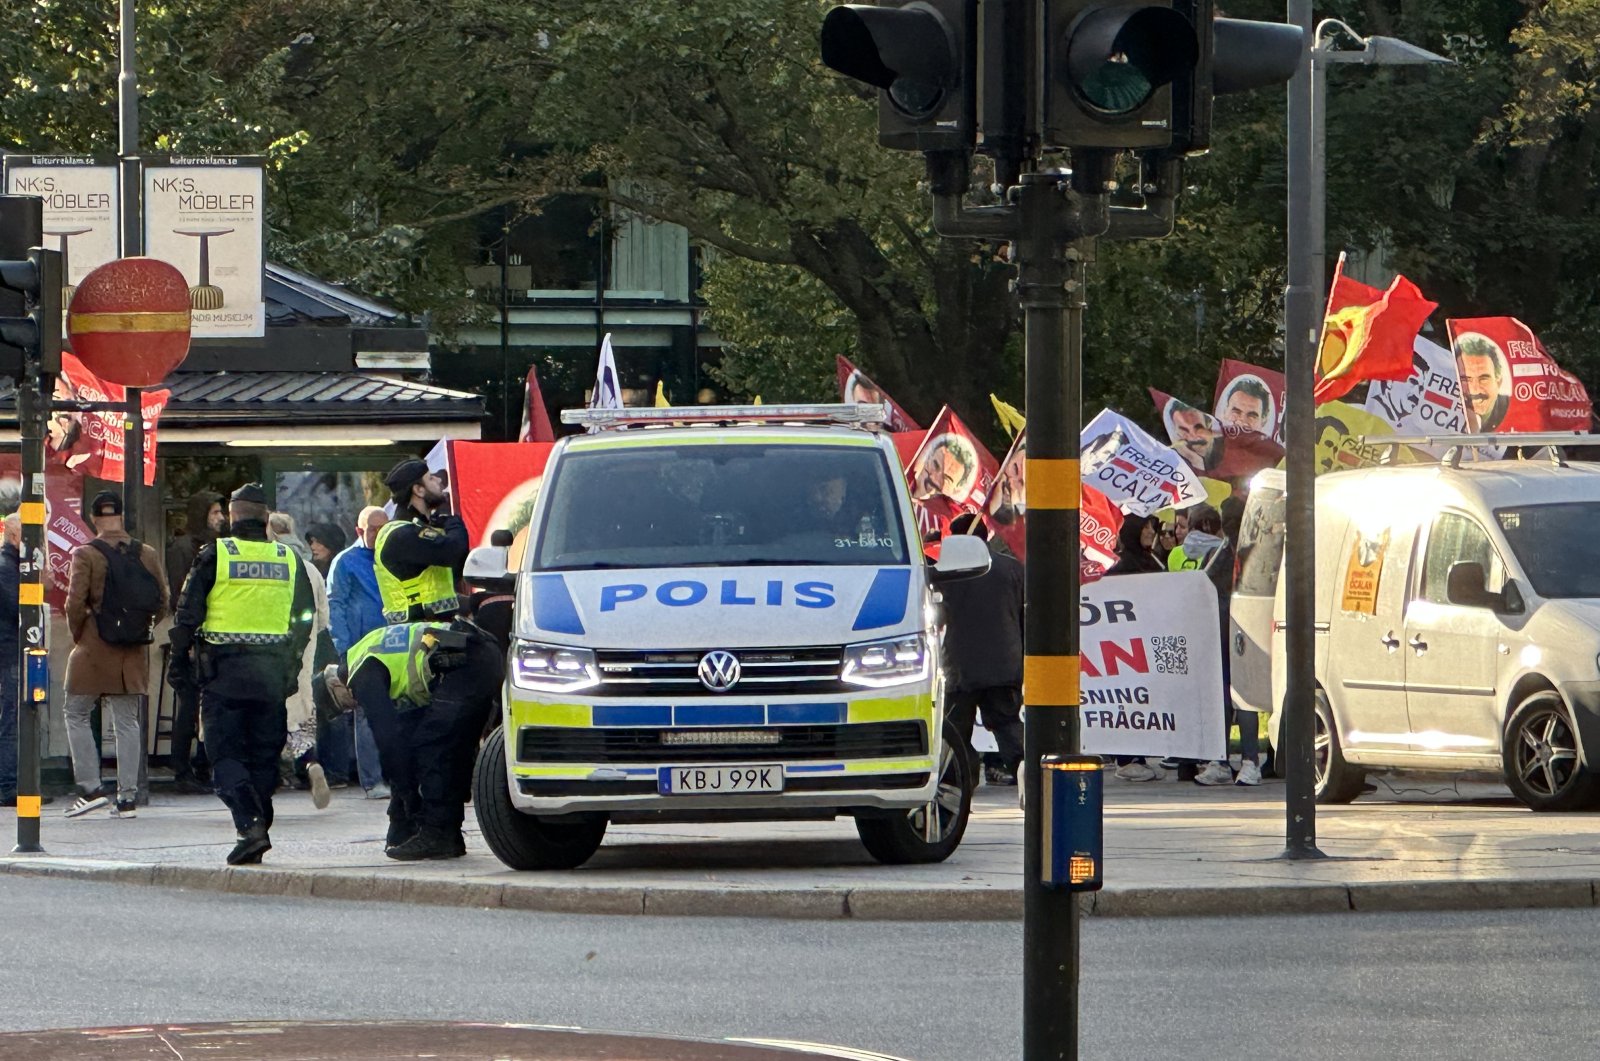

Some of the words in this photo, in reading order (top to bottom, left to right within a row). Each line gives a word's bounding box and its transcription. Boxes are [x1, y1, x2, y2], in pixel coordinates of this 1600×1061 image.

[32, 156, 94, 165] kulturreklam.se
[169, 156, 238, 165] kulturreklam.se
[16, 177, 55, 192] NK:S
[153, 178, 195, 193] NK:S
[41, 189, 110, 209] MÖBLER
[179, 190, 254, 210] MÖBLER
[1120, 446, 1193, 501] FREEDOM
[1136, 469, 1160, 486] FOR
[236, 562, 283, 579] POLIS
[600, 579, 836, 613] POLIS
[1085, 705, 1176, 731] FRÅGAN
[680, 770, 721, 790] KBJ
[729, 768, 772, 789] 99K
